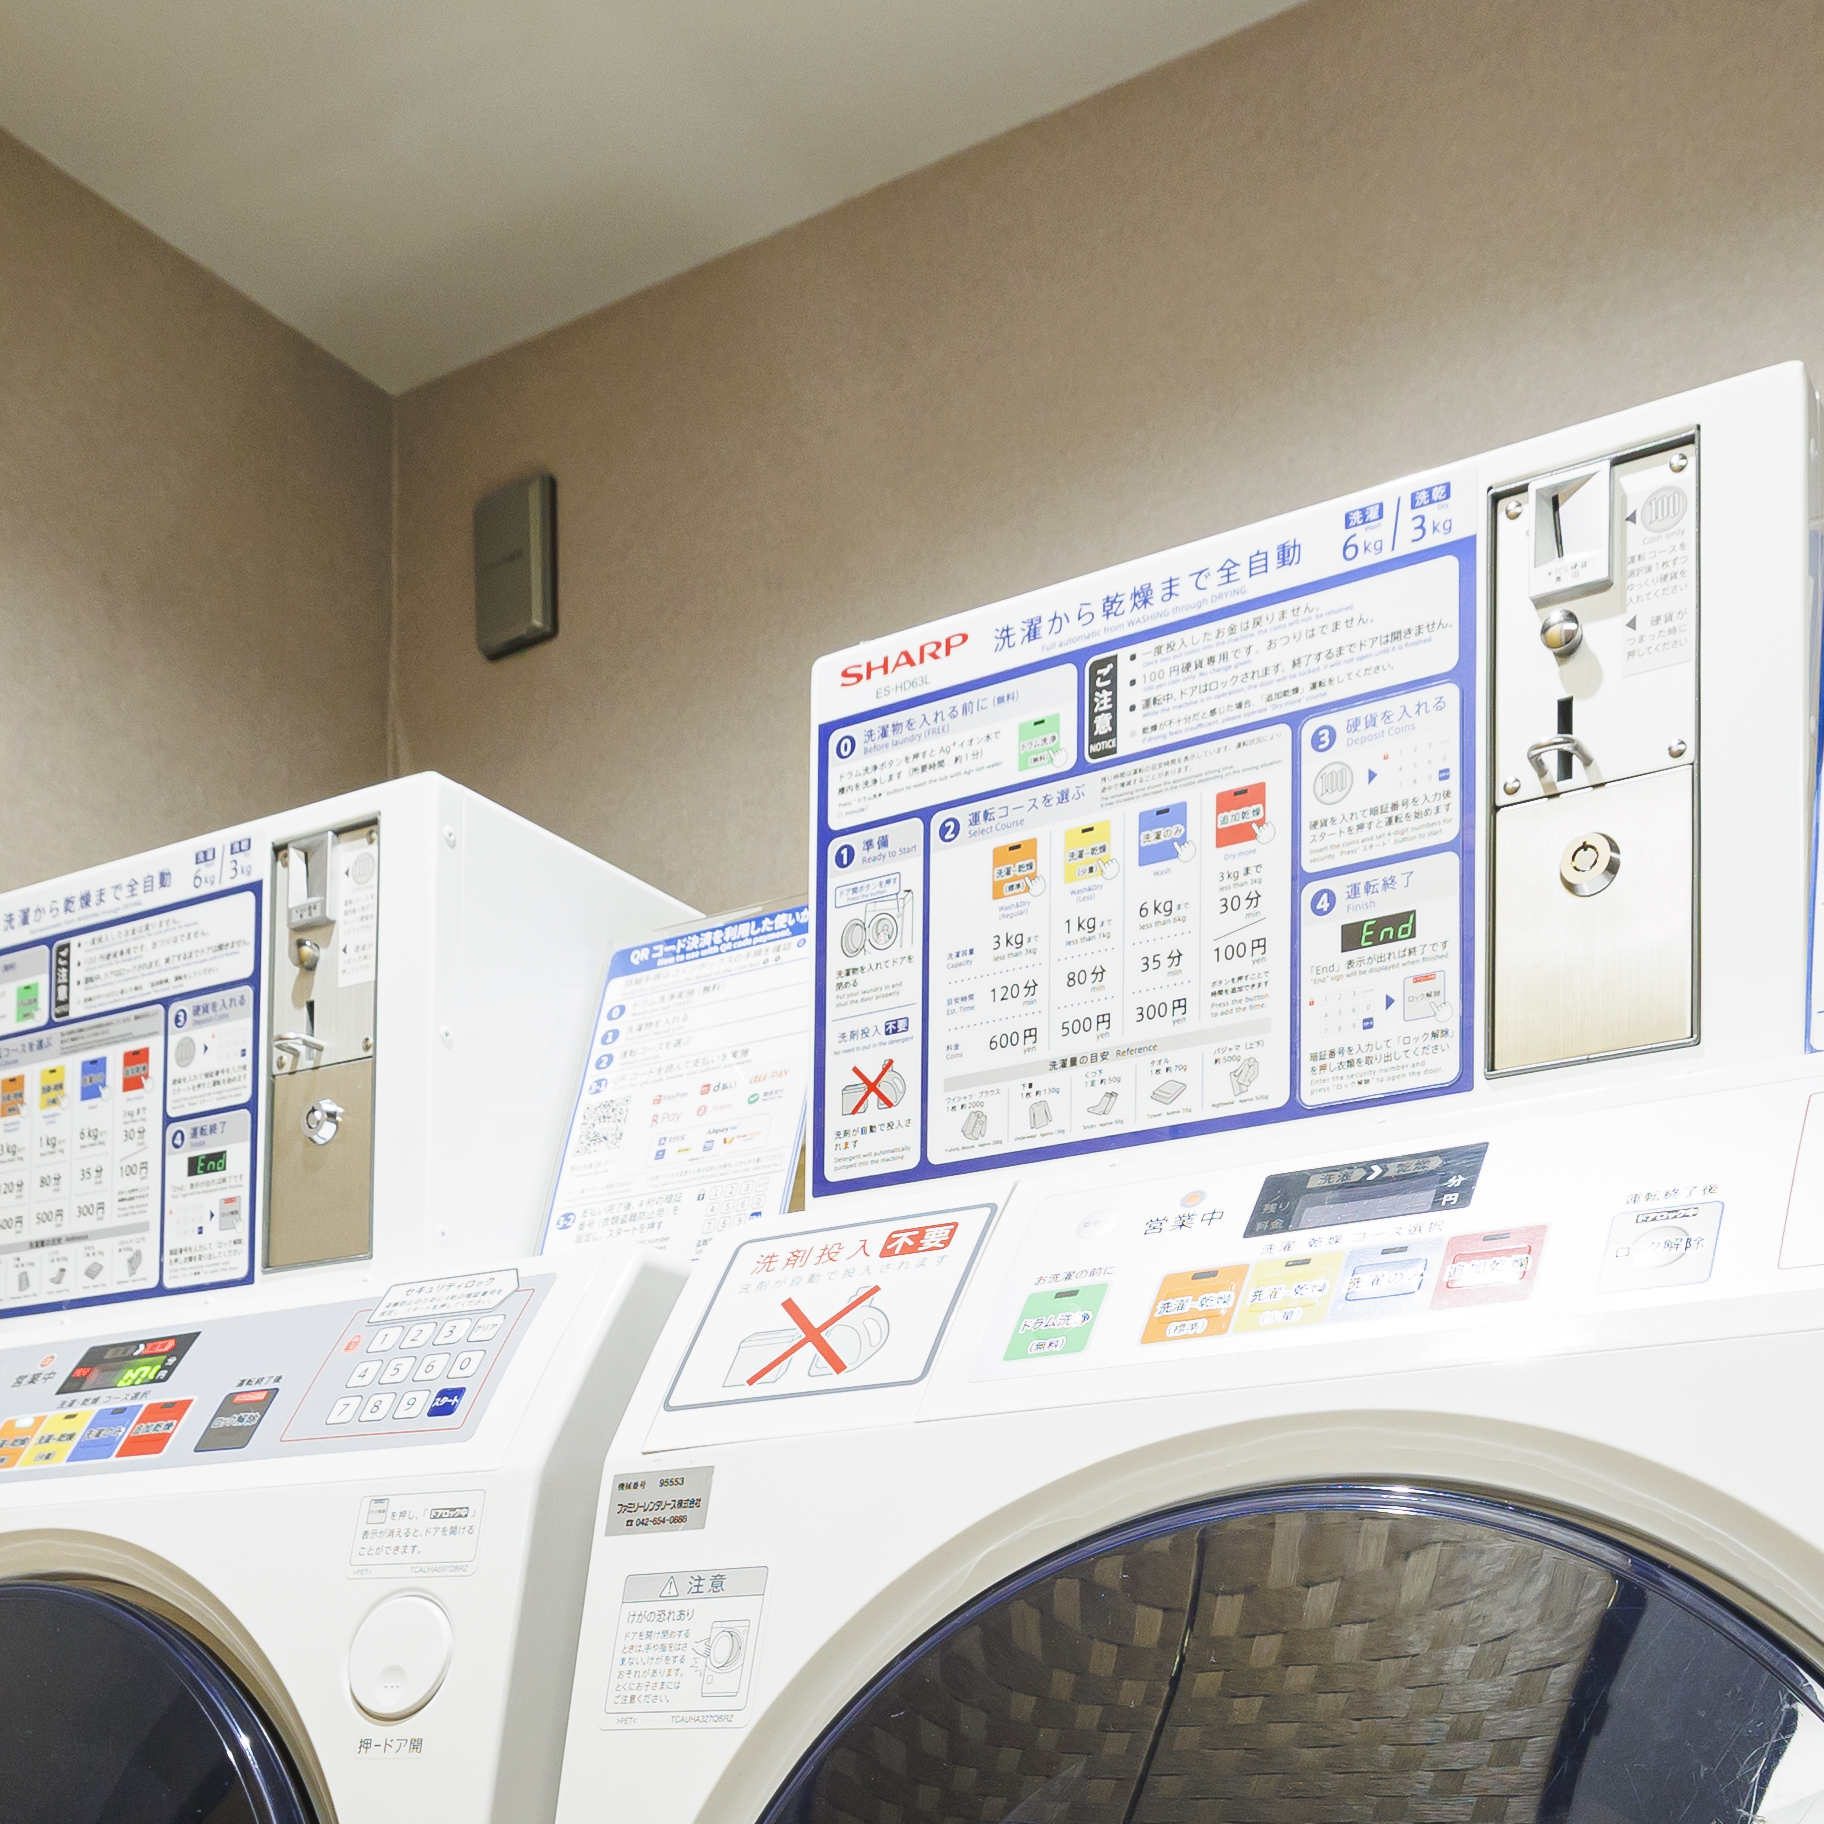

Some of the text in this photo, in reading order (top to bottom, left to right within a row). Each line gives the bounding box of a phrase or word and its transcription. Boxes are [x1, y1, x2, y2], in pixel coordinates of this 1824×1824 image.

[1642, 528, 1686, 545] Coin only
[994, 538, 1301, 654] 洗濯から乾燥まで全自動
[840, 633, 969, 687] SHARP
[1093, 663, 1114, 736] ご注意
[1346, 695, 1447, 735] 硬貨を入れる
[1089, 737, 1116, 754] NOTICE
[1318, 729, 1331, 749] 3
[1347, 722, 1416, 747] Deposit Coins
[968, 782, 1086, 828] 運転コースを選ぶ
[943, 820, 956, 839] 2
[968, 816, 1025, 838] Select Course
[1345, 871, 1415, 901] 運転終了
[1316, 892, 1330, 911] 4
[1346, 900, 1376, 914] Finish
[1360, 912, 1415, 947] End
[1115, 1042, 1158, 1058] Reference
[196, 1151, 226, 1174] End
[1445, 1174, 1466, 1188] 分
[1441, 1193, 1460, 1206] 円
[887, 1225, 954, 1253] 不要
[460, 1357, 471, 1370] 0
[370, 1400, 382, 1414] 8
[686, 1573, 727, 1595] 注意
